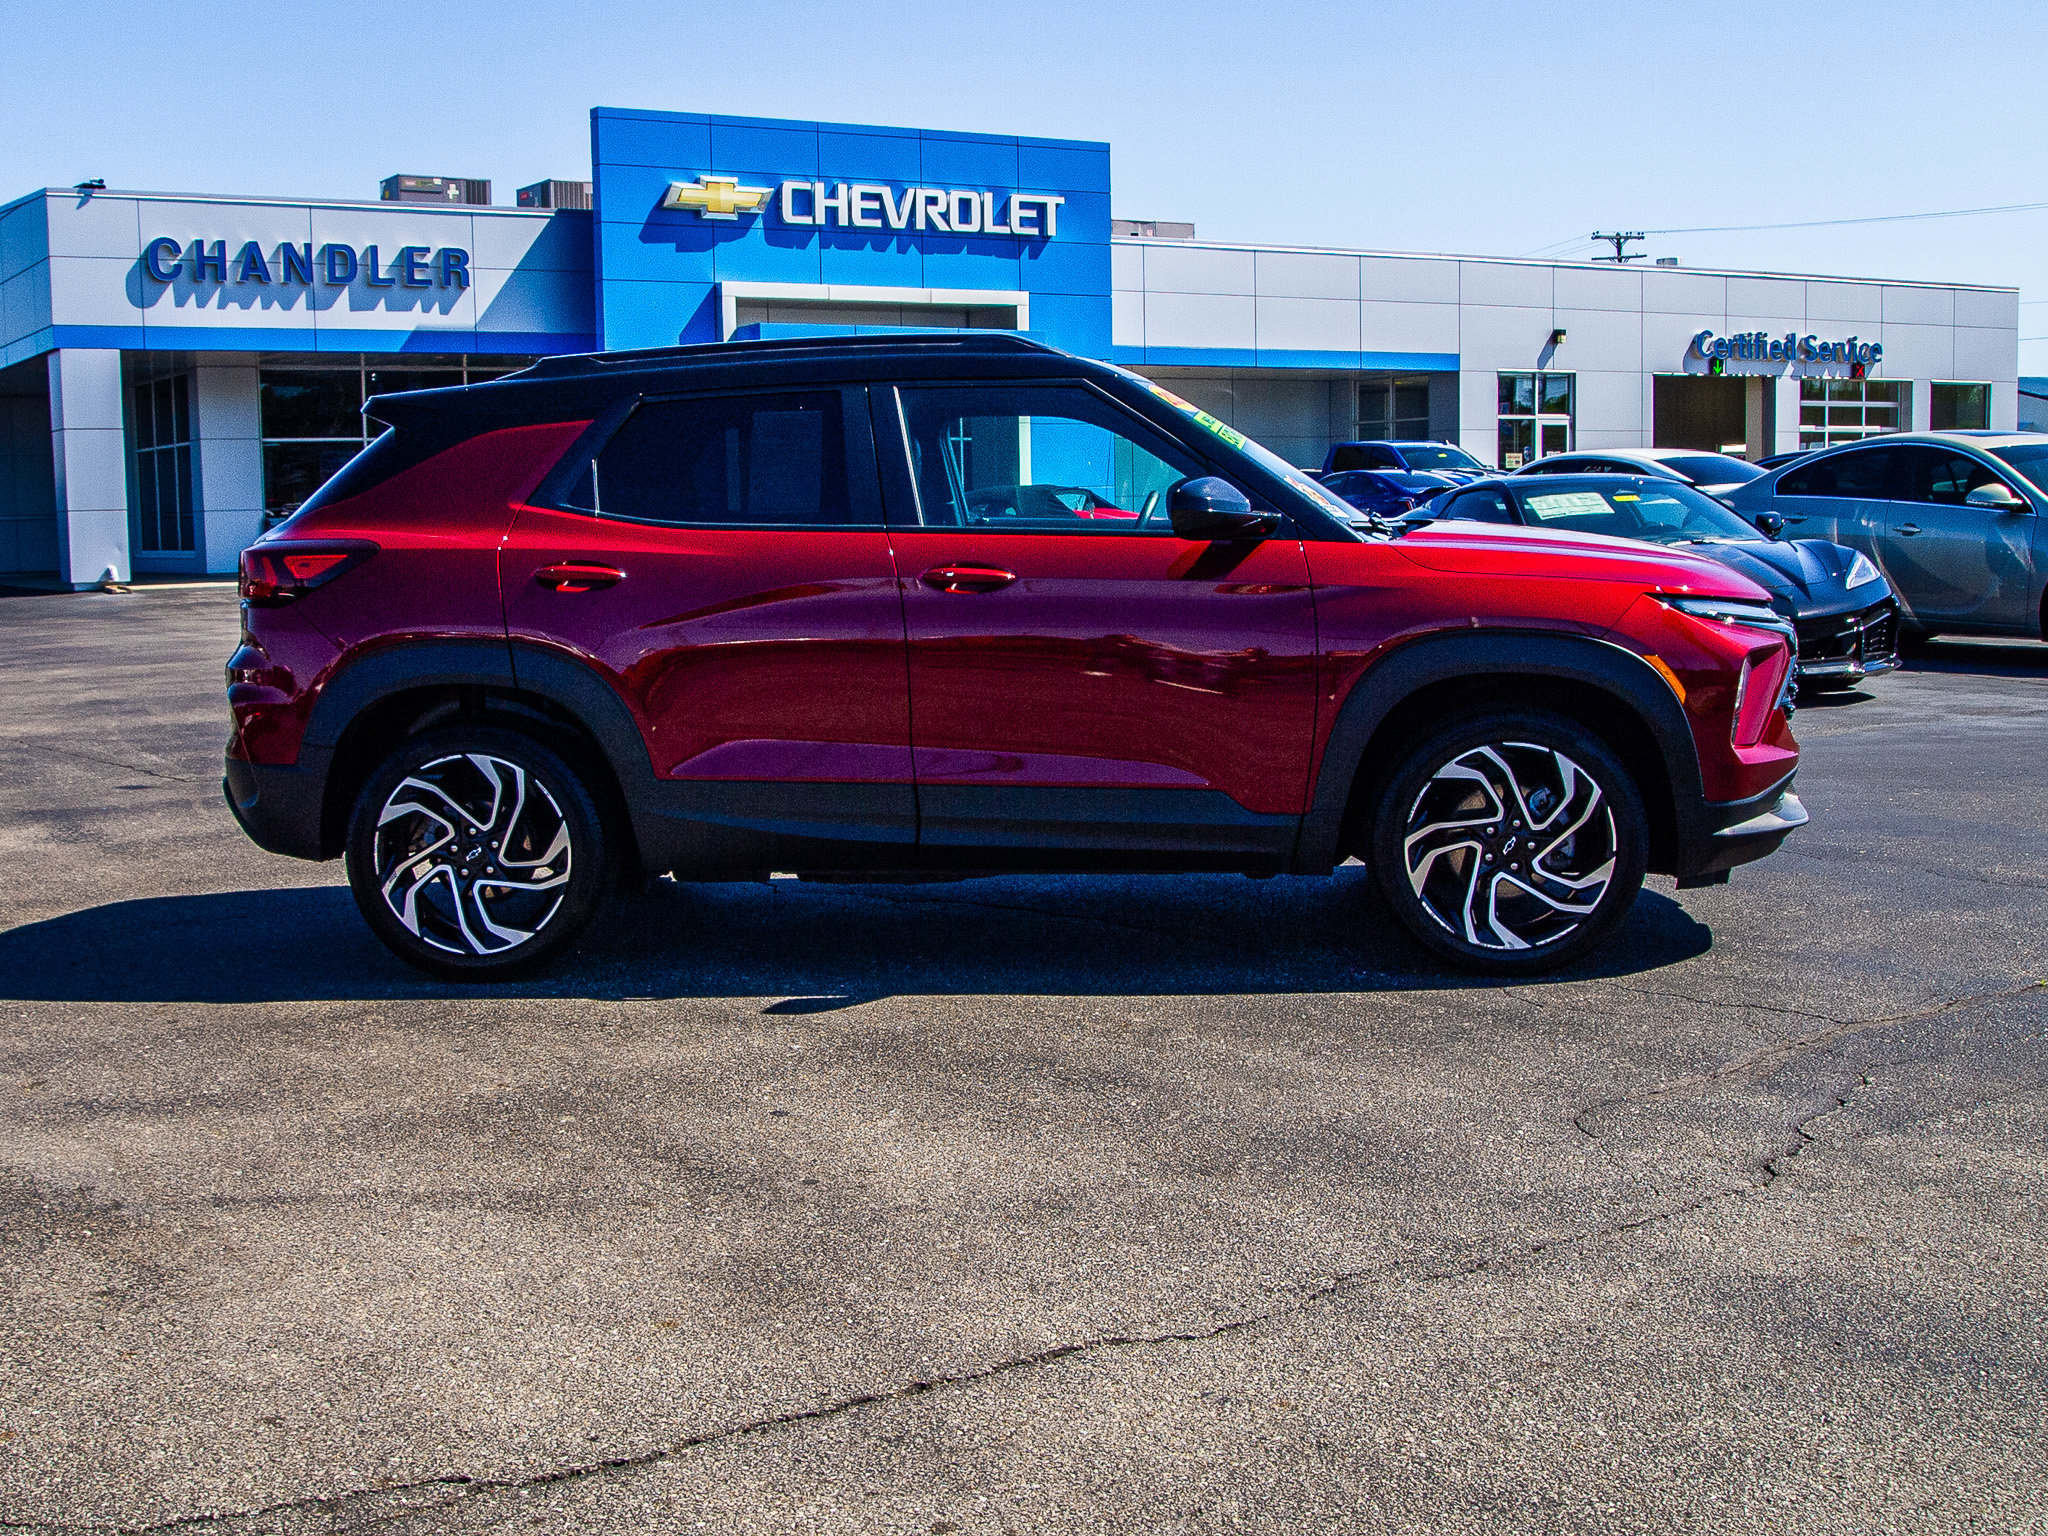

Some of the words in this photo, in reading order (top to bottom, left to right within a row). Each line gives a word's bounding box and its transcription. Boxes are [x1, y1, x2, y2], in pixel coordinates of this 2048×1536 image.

[780, 180, 1065, 237] CHEVROLET
[146, 236, 471, 289] CHANDLER
[1694, 329, 1796, 361] Certified
[1804, 334, 1884, 363] Service
